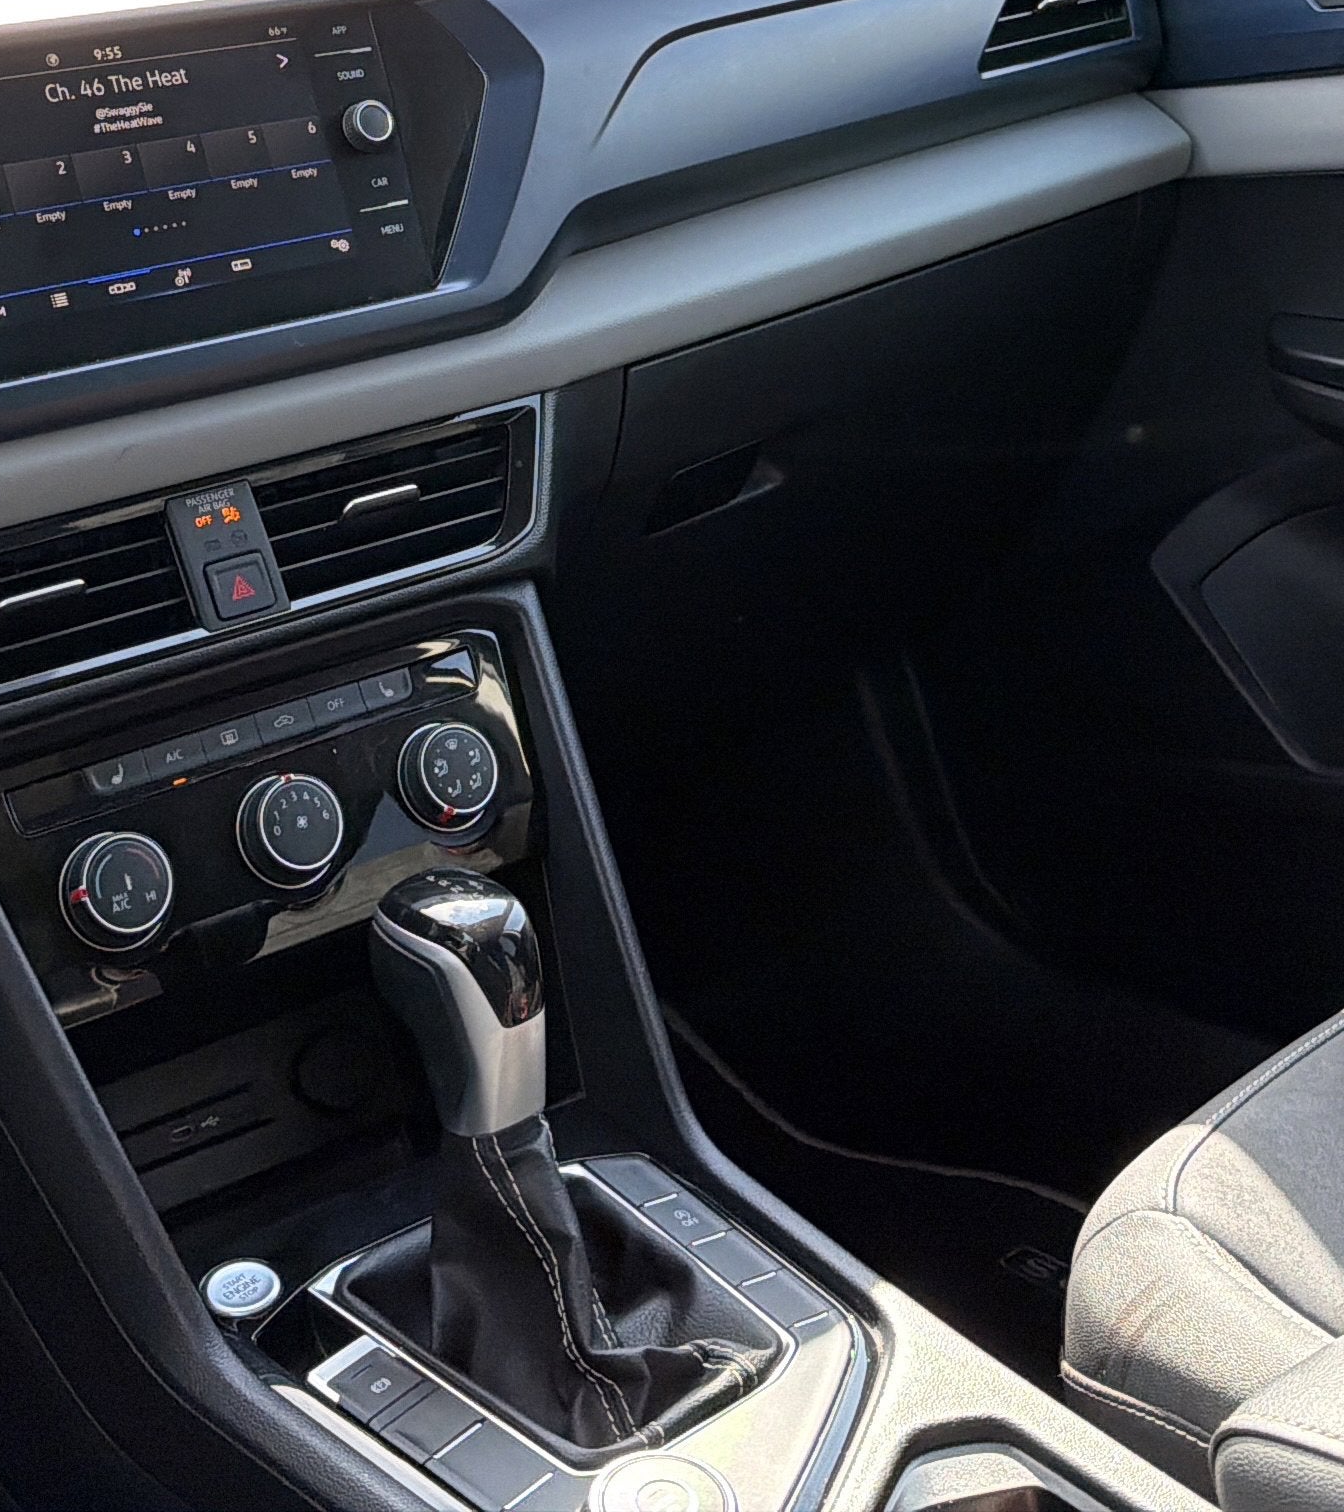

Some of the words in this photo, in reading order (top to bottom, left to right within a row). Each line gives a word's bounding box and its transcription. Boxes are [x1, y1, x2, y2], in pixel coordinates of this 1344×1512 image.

[332, 26, 347, 35] APP
[94, 46, 122, 61] 9:55
[337, 69, 365, 81] SOUND
[45, 84, 76, 103] Ch.
[81, 79, 105, 98] 46
[108, 75, 143, 94] The
[149, 68, 189, 88] Heat
[94, 115, 163, 133] #TheHeatWave
[308, 121, 317, 134] 6
[247, 131, 256, 144] 5
[186, 140, 196, 154] 4
[122, 151, 132, 165] 3
[56, 161, 67, 175] 2
[291, 167, 318, 180] Empty
[231, 176, 258, 190] Empty
[371, 177, 388, 188] CAR
[168, 187, 196, 202] Empty
[103, 199, 132, 213] Empty
[36, 210, 66, 224] Empty
[380, 223, 404, 235] MENU
[185, 487, 235, 507] PASSENGER
[195, 514, 212, 527] OFF
[327, 698, 345, 711] OFF
[166, 748, 184, 763] A/C
[145, 891, 157, 903] HI
[112, 900, 132, 913] A/C
[222, 1273, 246, 1290] START
[239, 1287, 258, 1301] STOP
